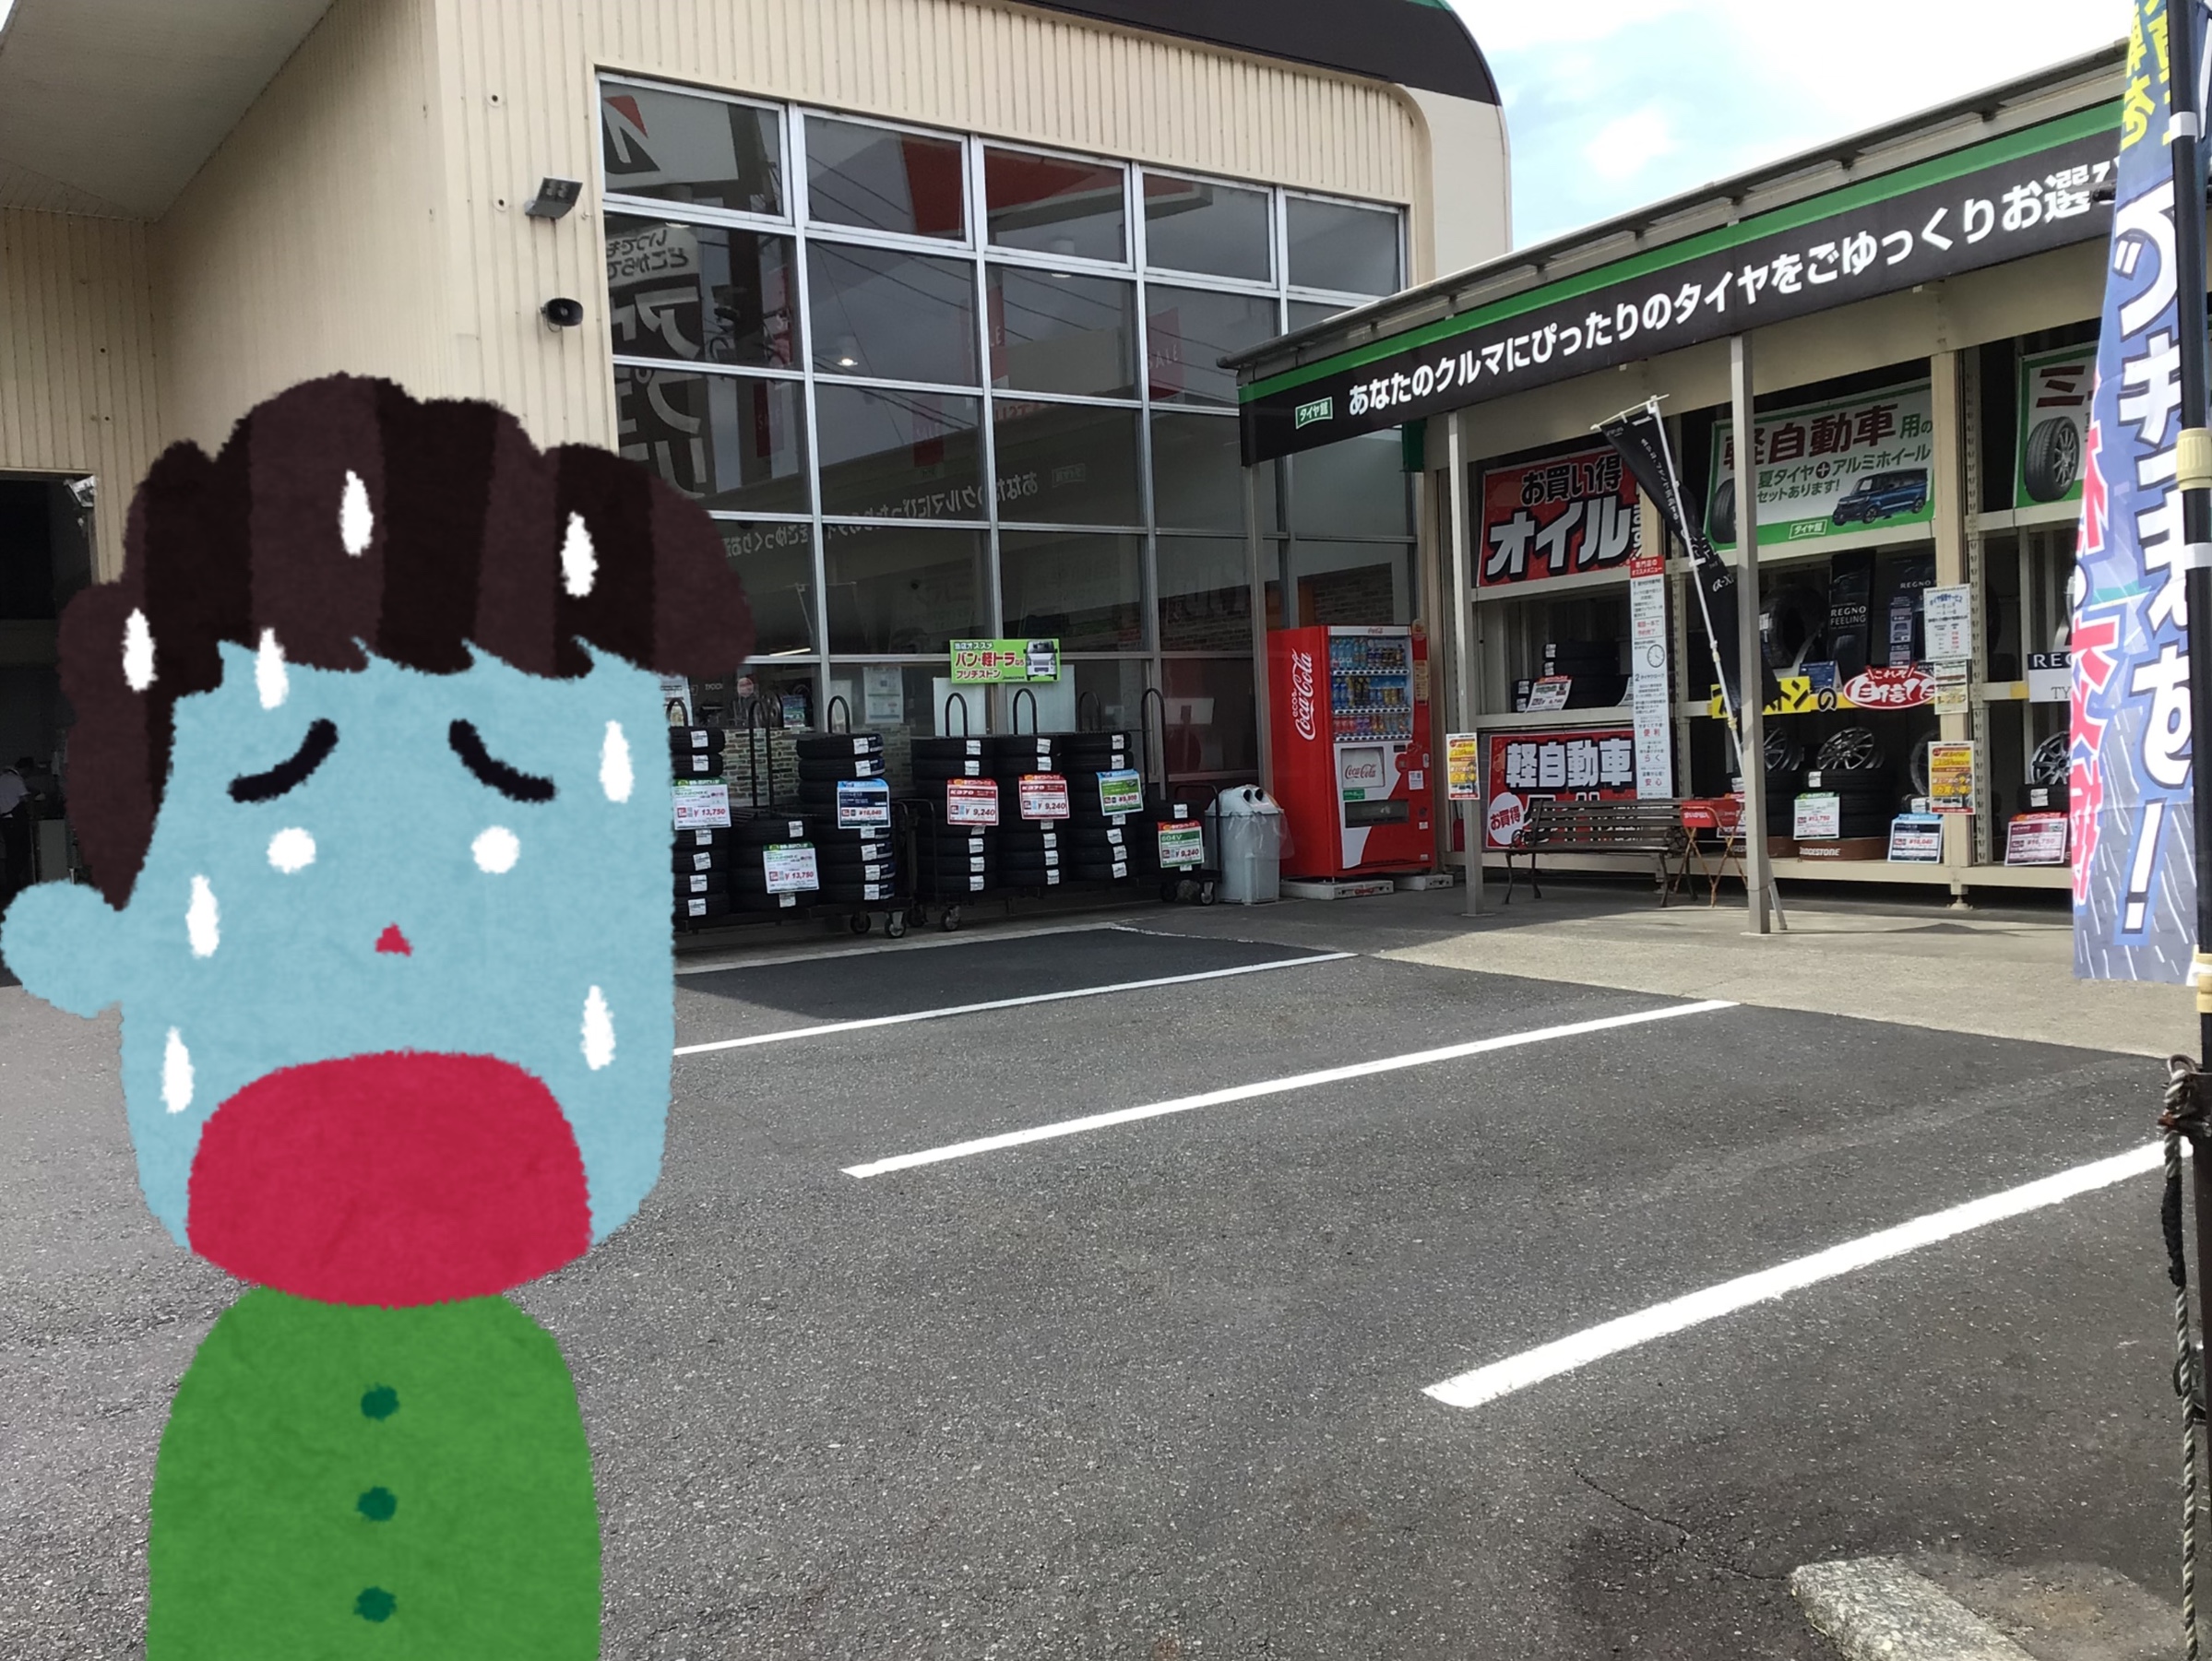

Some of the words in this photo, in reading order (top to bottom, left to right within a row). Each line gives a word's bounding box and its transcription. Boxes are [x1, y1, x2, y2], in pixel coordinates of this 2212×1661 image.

[1486, 496, 1632, 577] オイル
[1830, 606, 1867, 617] REGNO
[1830, 614, 1867, 626] FEELING
[1505, 738, 1633, 789] 軽自動車
